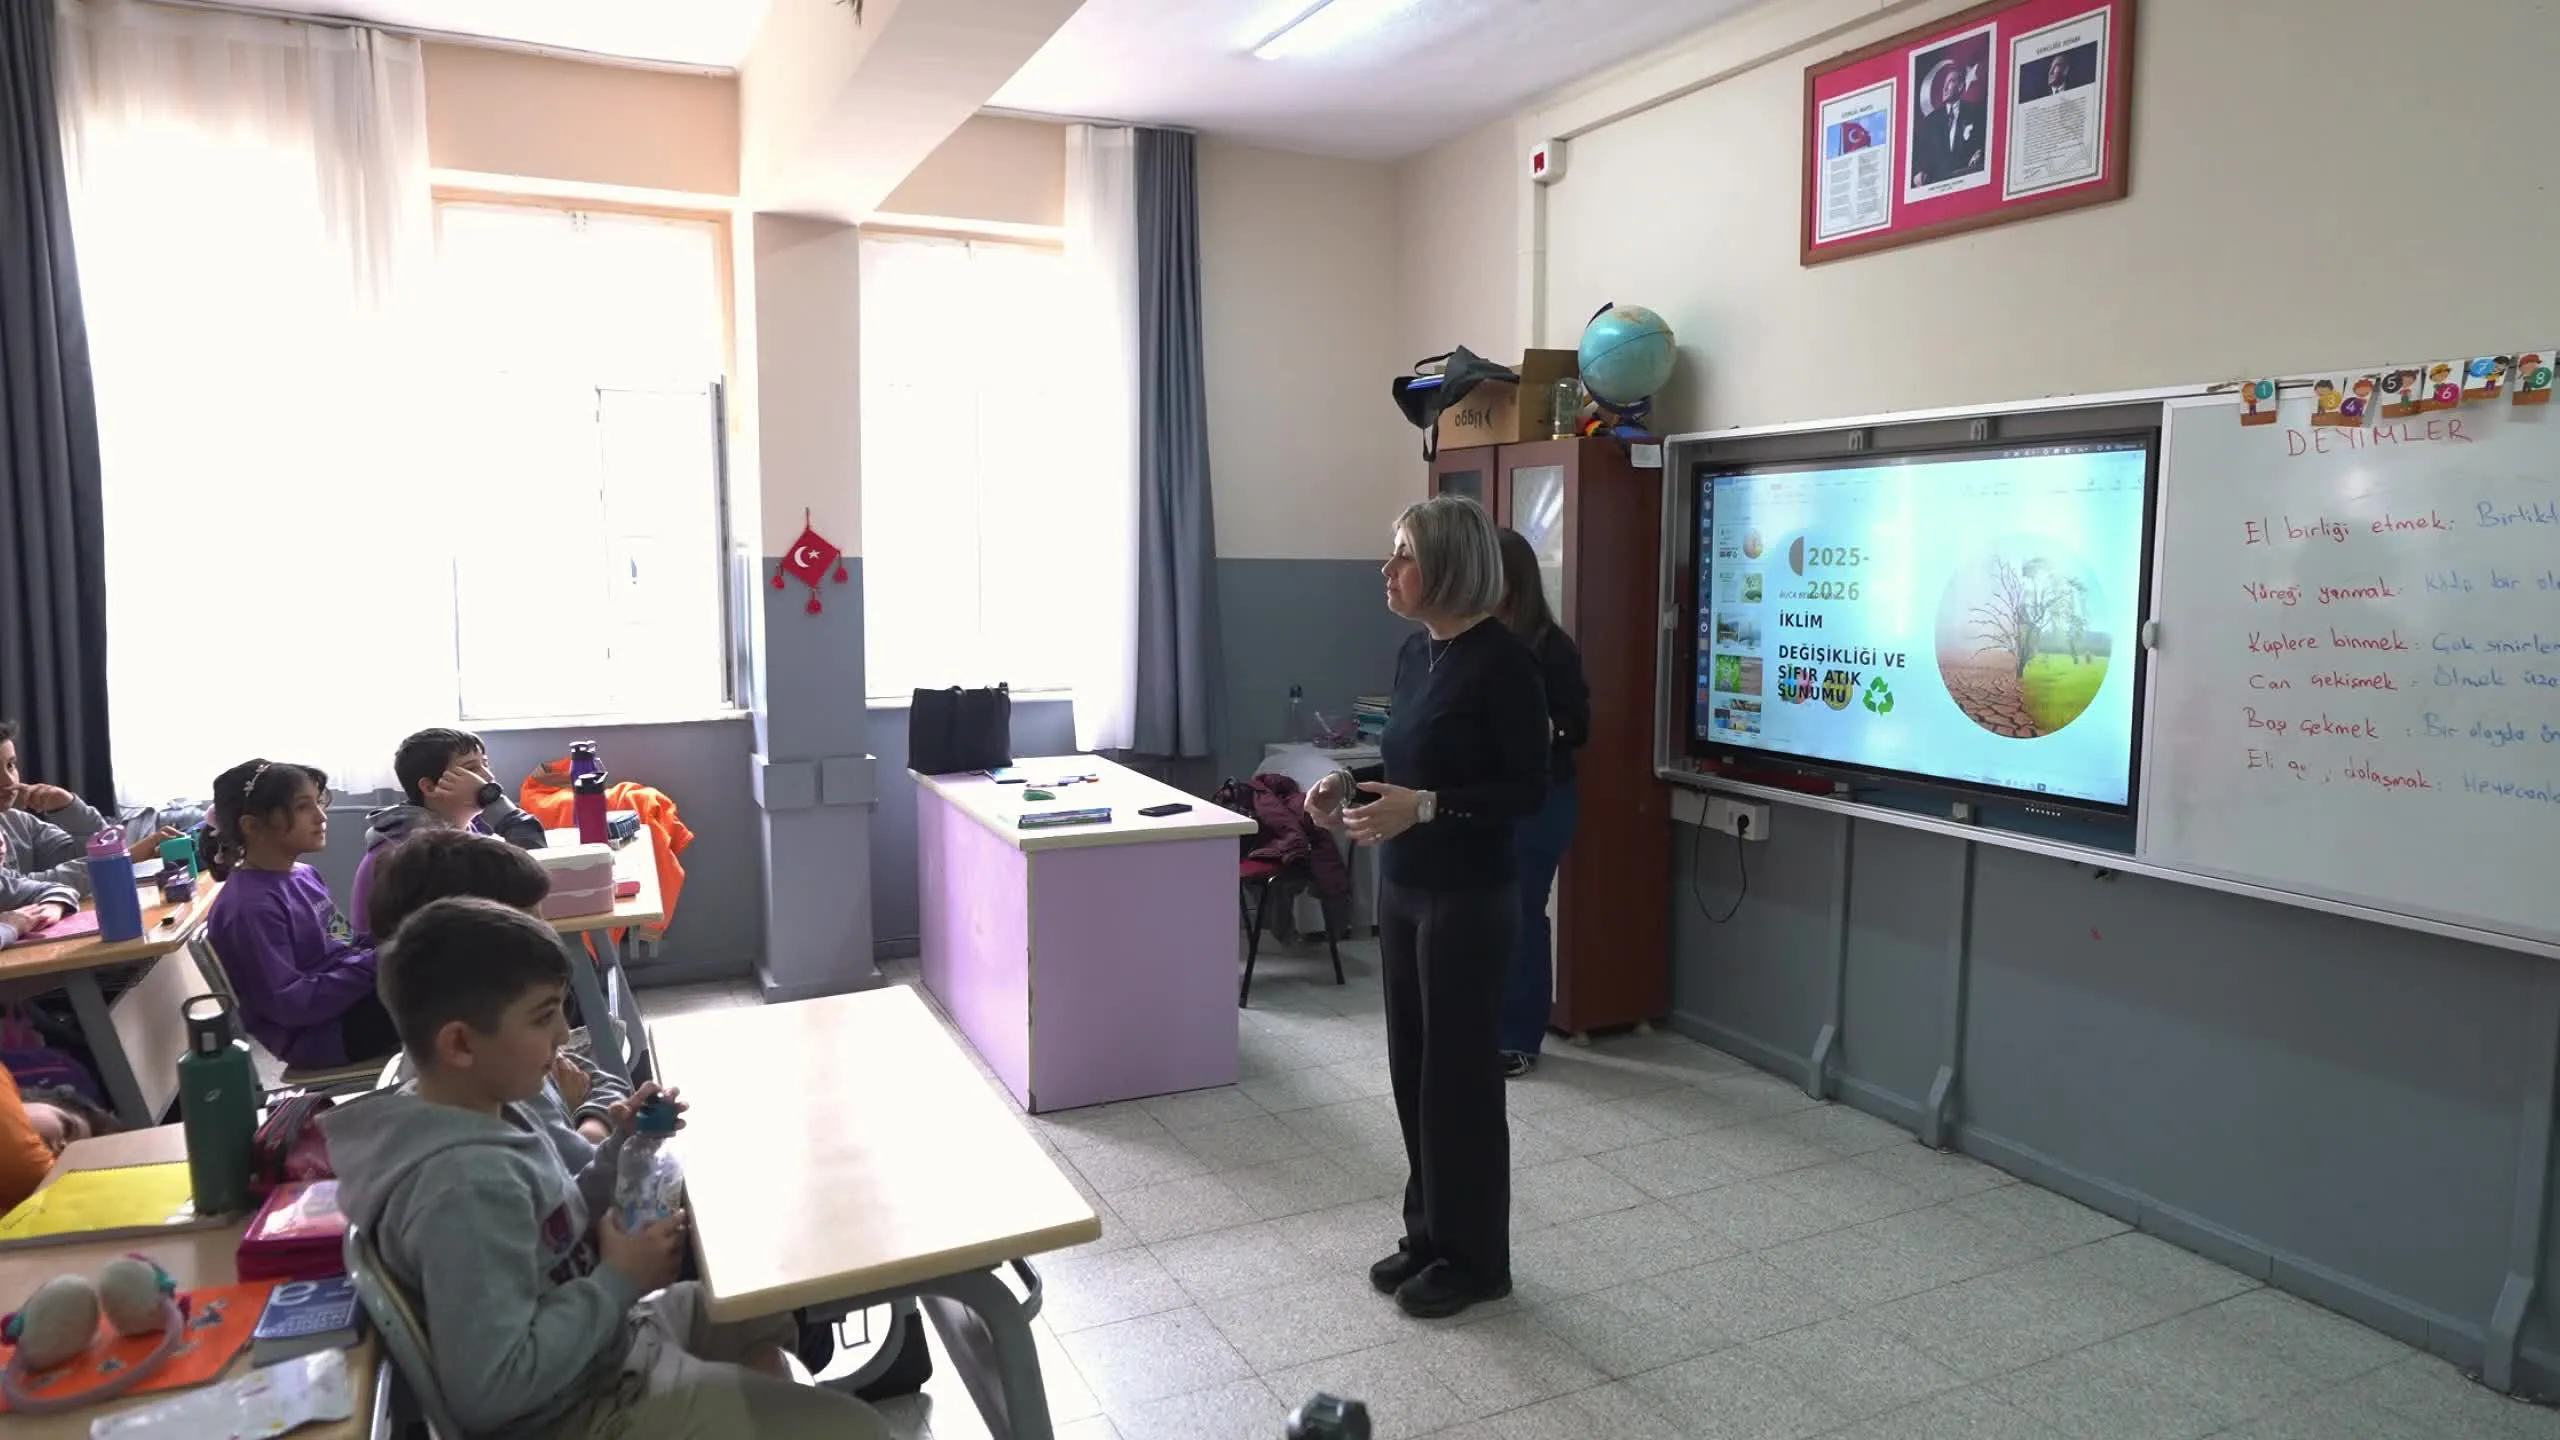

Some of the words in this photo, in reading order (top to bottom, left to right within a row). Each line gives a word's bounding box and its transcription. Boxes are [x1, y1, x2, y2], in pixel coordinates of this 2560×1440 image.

[2385, 374, 2397, 391] 5
[2535, 370, 2545, 386] 8
[2326, 393, 2336, 408] 3
[2441, 386, 2452, 402] 6
[2345, 399, 2357, 415] 4
[2245, 517, 2271, 545] El
[1807, 546, 1871, 568] 2025-
[1806, 580, 1860, 602] 2026
[1778, 610, 1823, 629] İKLİM
[1777, 644, 1877, 668] DEĞİŞİKLİĞİ
[1884, 652, 1906, 669] VE
[1823, 669, 1862, 687] ATIK
[2249, 675, 2292, 690] Can
[1777, 683, 1847, 704] SUNUMU
